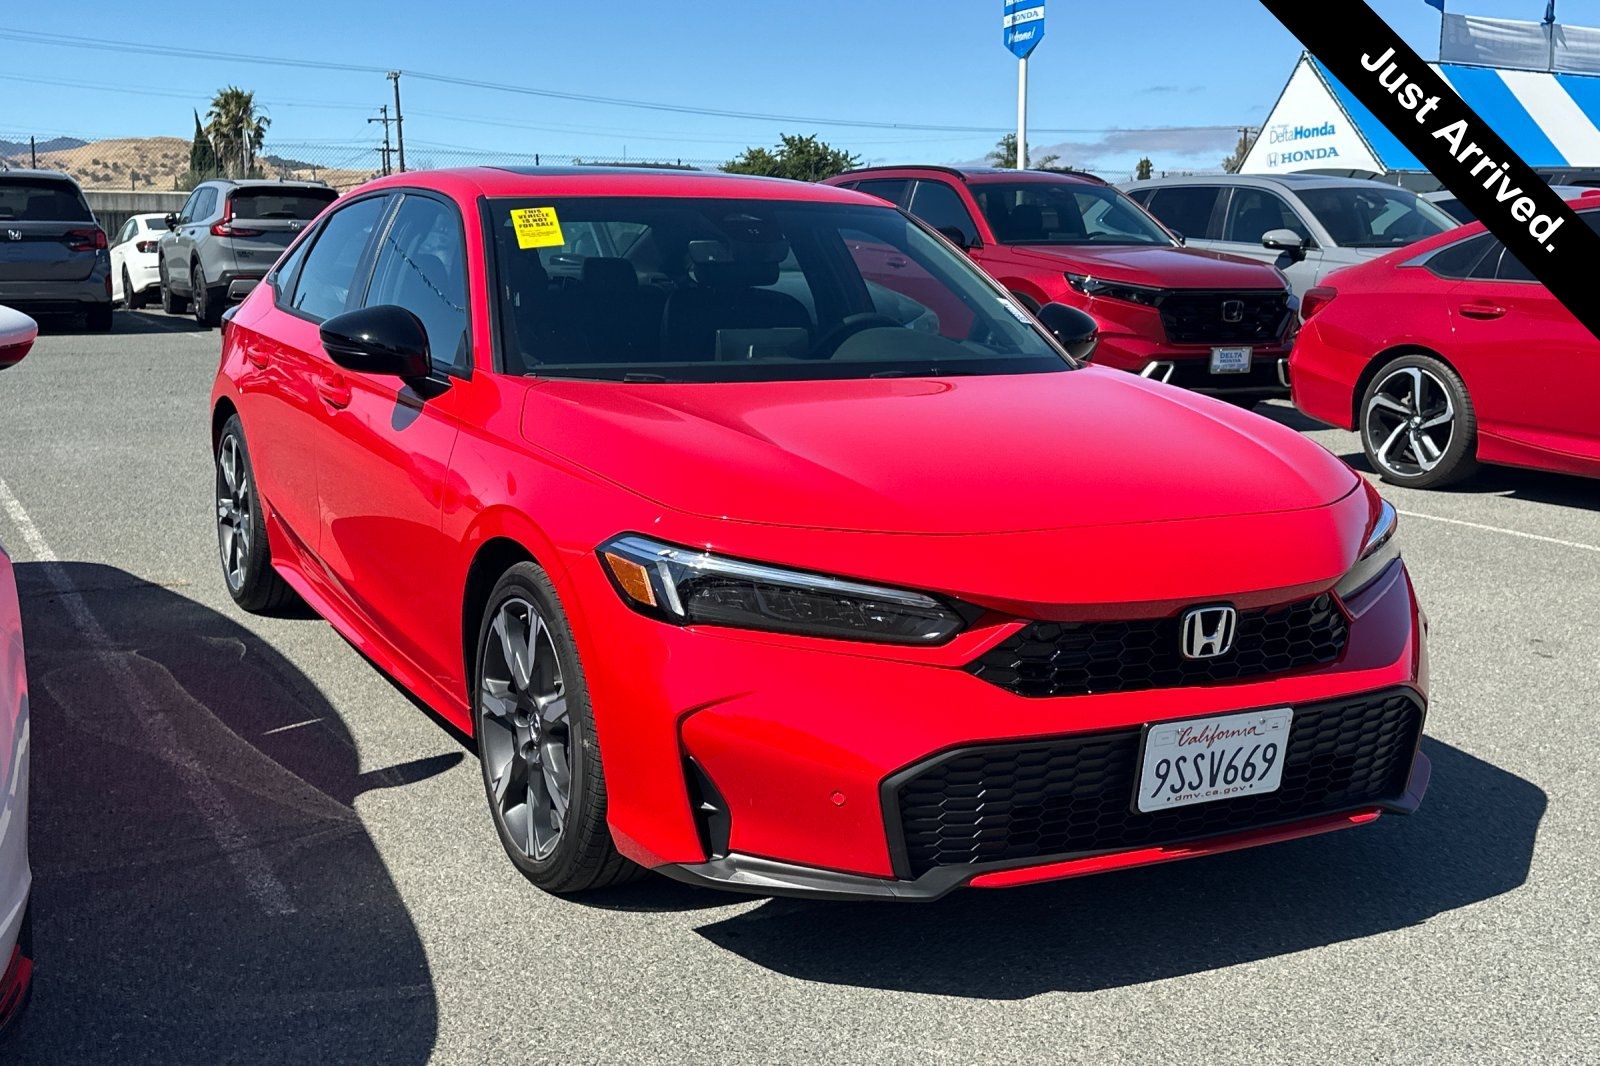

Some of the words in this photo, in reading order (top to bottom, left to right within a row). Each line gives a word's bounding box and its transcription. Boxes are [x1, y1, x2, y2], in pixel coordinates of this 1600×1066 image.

[1280, 147, 1340, 164] HONDA
[1178, 724, 1265, 749] California
[1151, 742, 1278, 798] 9SSV669
